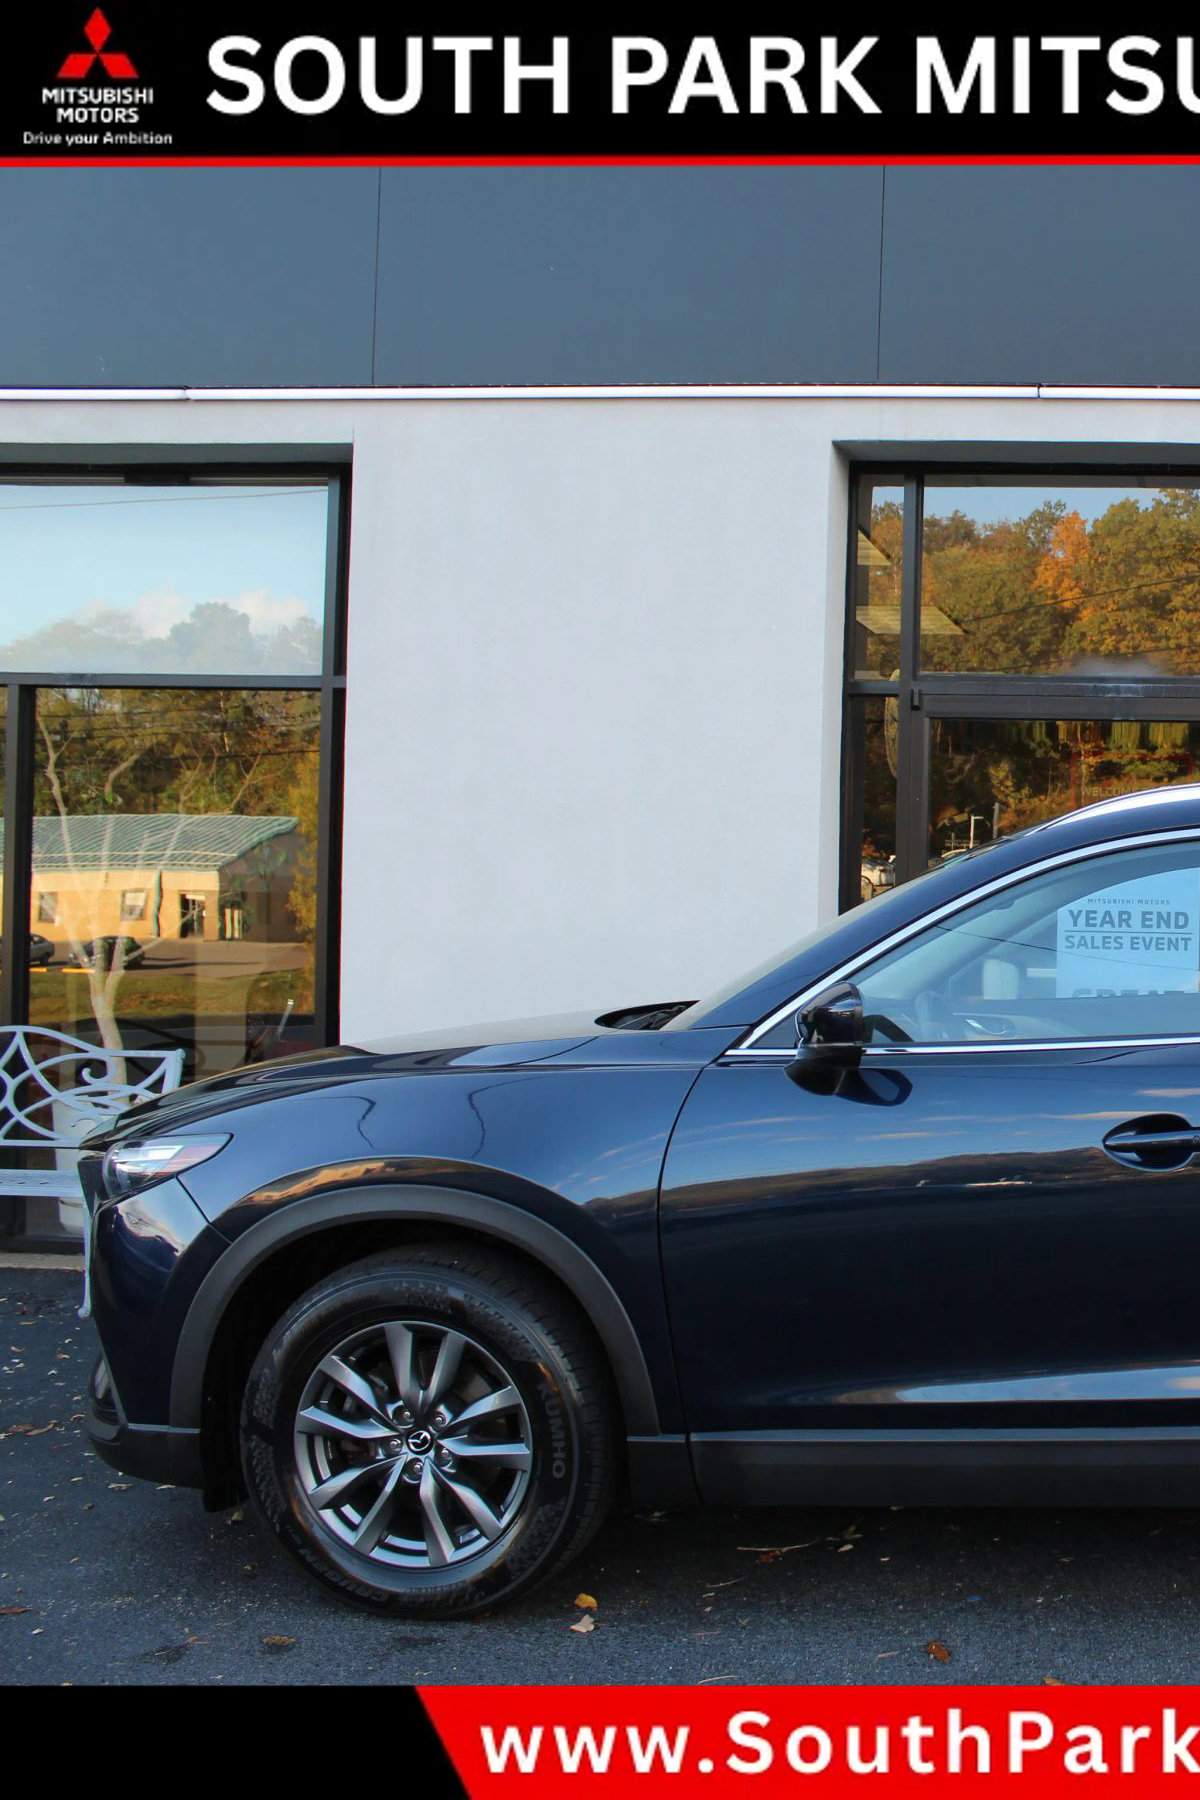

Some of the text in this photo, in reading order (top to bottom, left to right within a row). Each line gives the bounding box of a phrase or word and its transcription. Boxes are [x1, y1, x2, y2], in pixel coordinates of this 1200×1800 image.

[1067, 909, 1190, 930] YEAR END
[1064, 934, 1192, 951] SALES EVENT
[536, 1384, 567, 1479] KUMHO
